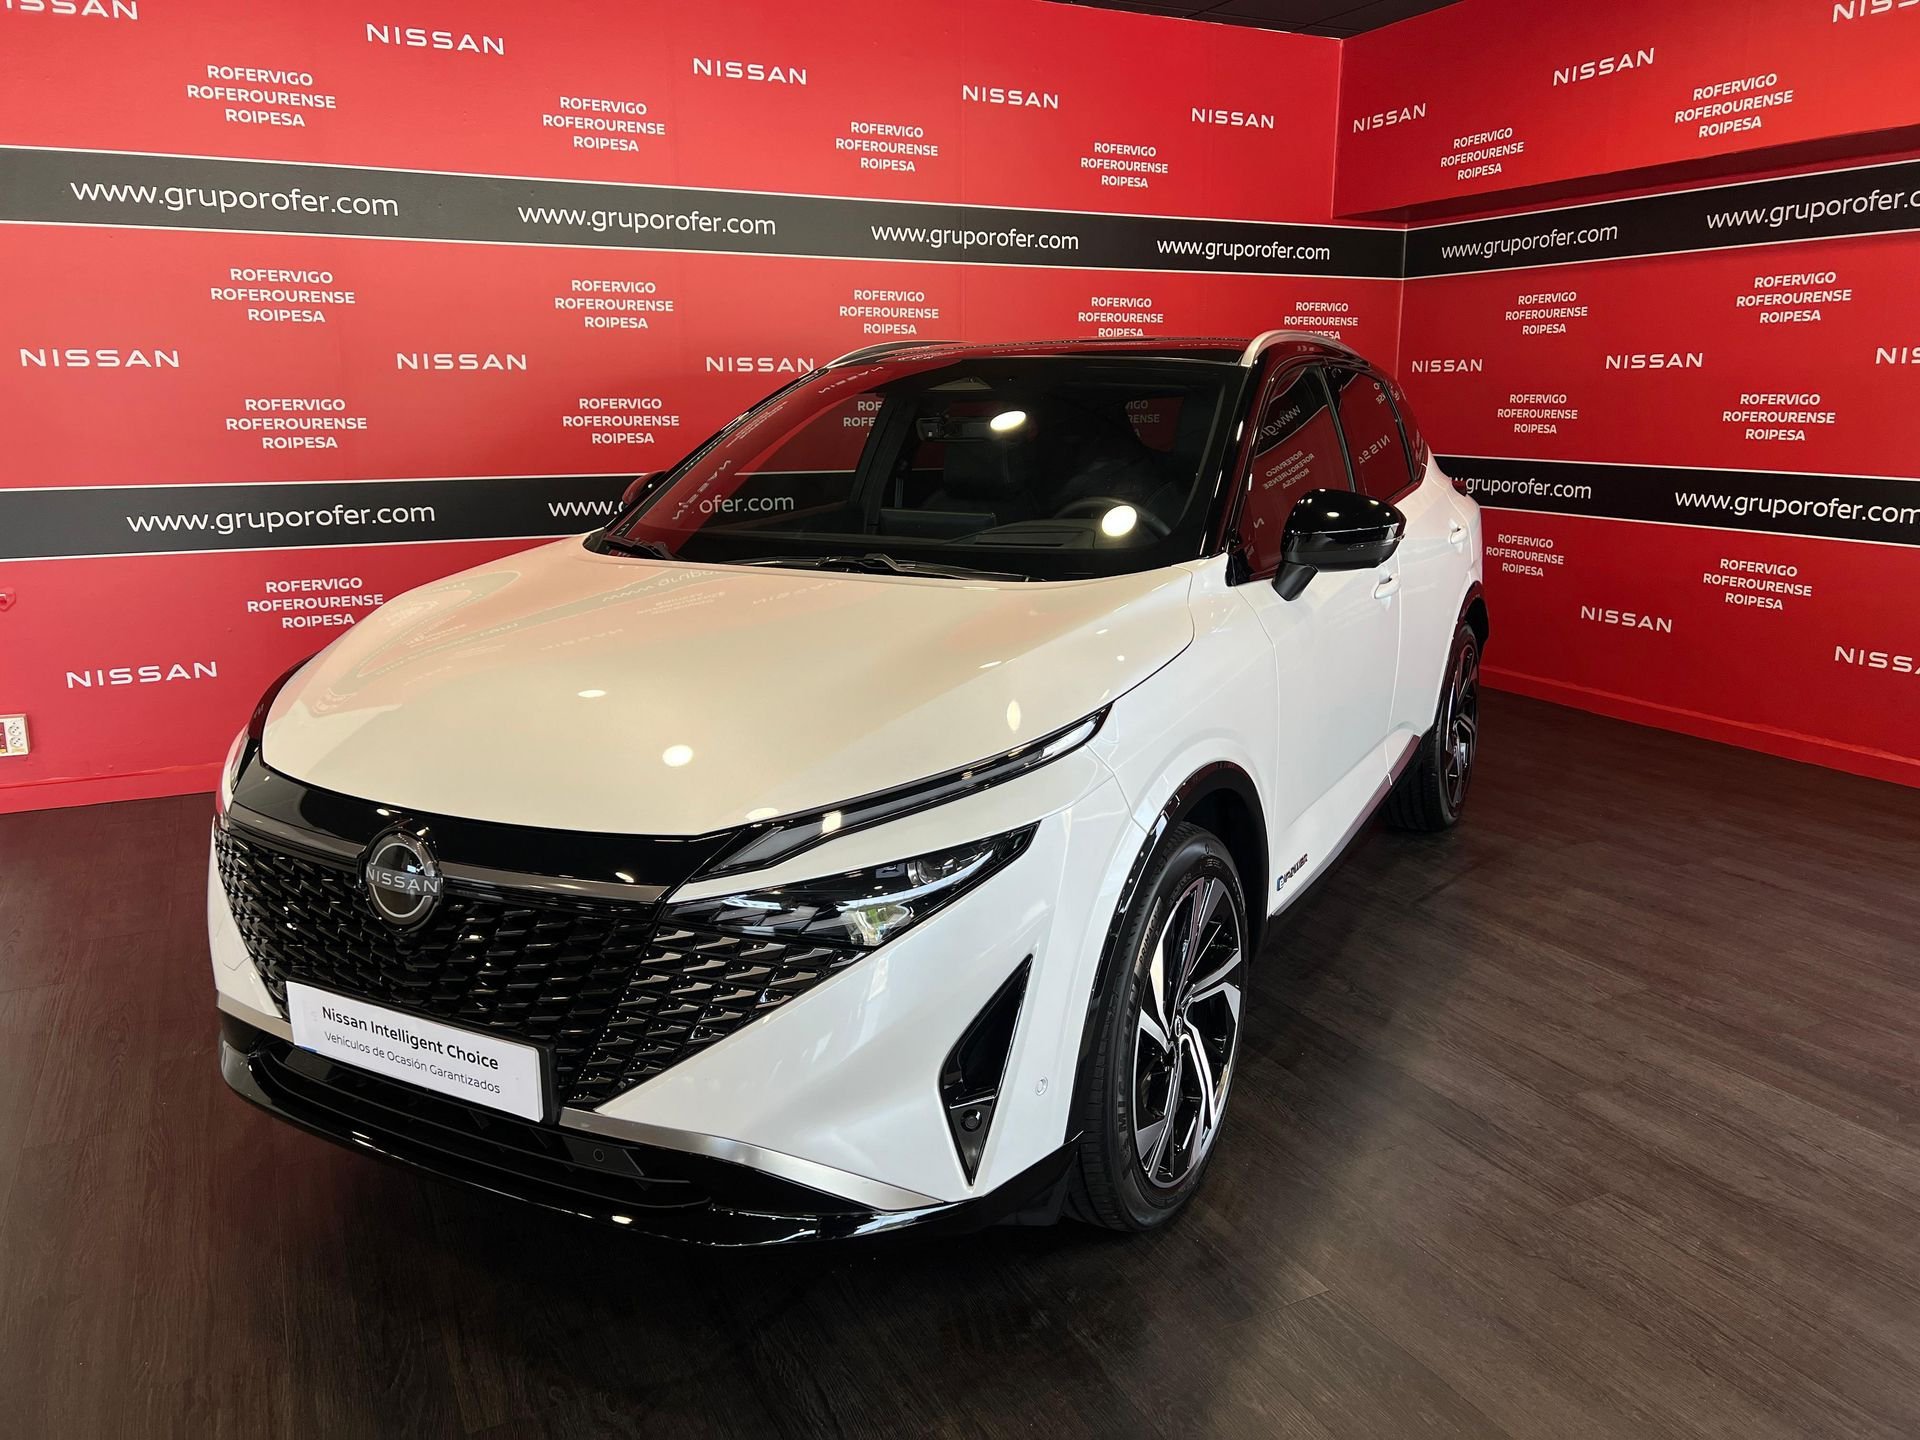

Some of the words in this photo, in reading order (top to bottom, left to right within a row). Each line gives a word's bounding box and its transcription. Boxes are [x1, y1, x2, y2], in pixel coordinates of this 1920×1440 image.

[367, 24, 504, 55] NISSAN
[694, 58, 806, 84] NISSAN
[1554, 48, 1654, 86] NISSAN
[208, 65, 312, 86] ROFERVIGO
[1694, 74, 1777, 100] ROFERVIGO
[187, 85, 336, 108] ROFEROURENSE
[963, 85, 1058, 109] NISSAN
[560, 97, 646, 115] ROFERVIGO
[1675, 90, 1793, 123] ROFEROURENSE
[226, 109, 305, 126] ROIPESA
[543, 115, 665, 134] ROFEROURENSE
[1192, 108, 1273, 128] NISSAN
[1354, 103, 1425, 133] NISSAN
[851, 122, 923, 138] ROFERVIGO
[1699, 116, 1761, 137] ROIPESA
[574, 136, 639, 151] ROIPESA
[1454, 128, 1512, 148] ROFERVIGO
[836, 138, 938, 156] ROFEROURENSE
[1095, 143, 1156, 156] ROFERVIGO
[1441, 142, 1524, 167] ROFEROURENSE
[861, 158, 915, 171] ROIPESA
[1081, 158, 1168, 173] ROFEROURENSE
[1458, 163, 1501, 180] ROIPESA
[1102, 175, 1148, 187] ROIPESA
[70, 183, 398, 216] www.gruporofer.com
[518, 207, 775, 234] www.gruporofer.com
[871, 226, 1078, 249] www.gruporofer.com
[1442, 226, 1617, 258] www.gruporofer.com
[1157, 241, 1329, 260] www.gruporofer.com
[231, 269, 332, 283] ROFERVIGO
[1755, 272, 1836, 288] ROFERVIGO
[572, 280, 656, 293] ROFERVIGO
[211, 288, 355, 303] ROFEROURENSE
[854, 290, 924, 302] ROFERVIGO
[1092, 297, 1151, 307] ROFERVIGO
[1518, 292, 1576, 305] ROFERVIGO
[1737, 290, 1852, 306] ROFEROURENSE
[555, 298, 673, 311] ROFEROURENSE
[840, 306, 938, 318] ROFEROURENSE
[1296, 302, 1348, 312] ROFERVIGO
[248, 309, 325, 322] ROIPESA
[1079, 312, 1163, 323] ROFEROURENSE
[1284, 316, 1358, 326] ROFEROURENSE
[1506, 307, 1587, 320] ROFEROURENSE
[1760, 310, 1821, 323] ROIPESA
[585, 317, 648, 328] ROIPESA
[864, 324, 916, 334] ROIPESA
[1523, 324, 1566, 334] ROIPESA
[1098, 328, 1144, 337] ROIPESA
[20, 349, 179, 367] NISSAN
[397, 353, 526, 370] NISSAN
[706, 356, 814, 373] NISSAN
[1412, 359, 1482, 372] NISSAN
[1606, 353, 1703, 369] NISSAN
[245, 399, 345, 410] ROFERVIGO
[579, 398, 662, 409] ROFERVIGO
[1510, 394, 1566, 403] ROFERVIGO
[1740, 394, 1820, 405] ROFERVIGO
[563, 416, 679, 426] ROFEROURENSE
[1498, 409, 1578, 419] ROFEROURENSE
[1723, 411, 1835, 423] ROFEROURENSE
[226, 418, 367, 430] ROFEROURENSE
[1514, 424, 1557, 433] ROIPESA
[263, 437, 337, 448] ROIPESA
[592, 433, 654, 443] ROIPESA
[1746, 429, 1805, 440] ROIPESA
[126, 505, 434, 534] www.gruporofer.com
[1498, 534, 1553, 548] ROFERVIGO
[1486, 547, 1564, 564] ROFEROURENSE
[1502, 563, 1543, 576] ROIPESA
[1721, 559, 1797, 577] ROFERVIGO
[266, 578, 362, 593] ROFERVIGO
[1704, 573, 1812, 596] ROFEROURENSE
[248, 594, 384, 612] ROFEROURENSE
[1726, 593, 1783, 610] ROIPESA
[282, 614, 355, 628] ROIPESA
[1581, 606, 1672, 632] NISSAN
[1835, 646, 1920, 674] NISS
[66, 662, 217, 688] NISSAN
[366, 866, 438, 893] NISSAN
[322, 1006, 367, 1031] Nissan
[371, 1021, 444, 1055] Intelligent
[446, 1044, 499, 1070] Choice
[373, 1046, 385, 1058] de
[386, 1051, 428, 1072] Ocasión
[429, 1064, 501, 1094] Garantizados
